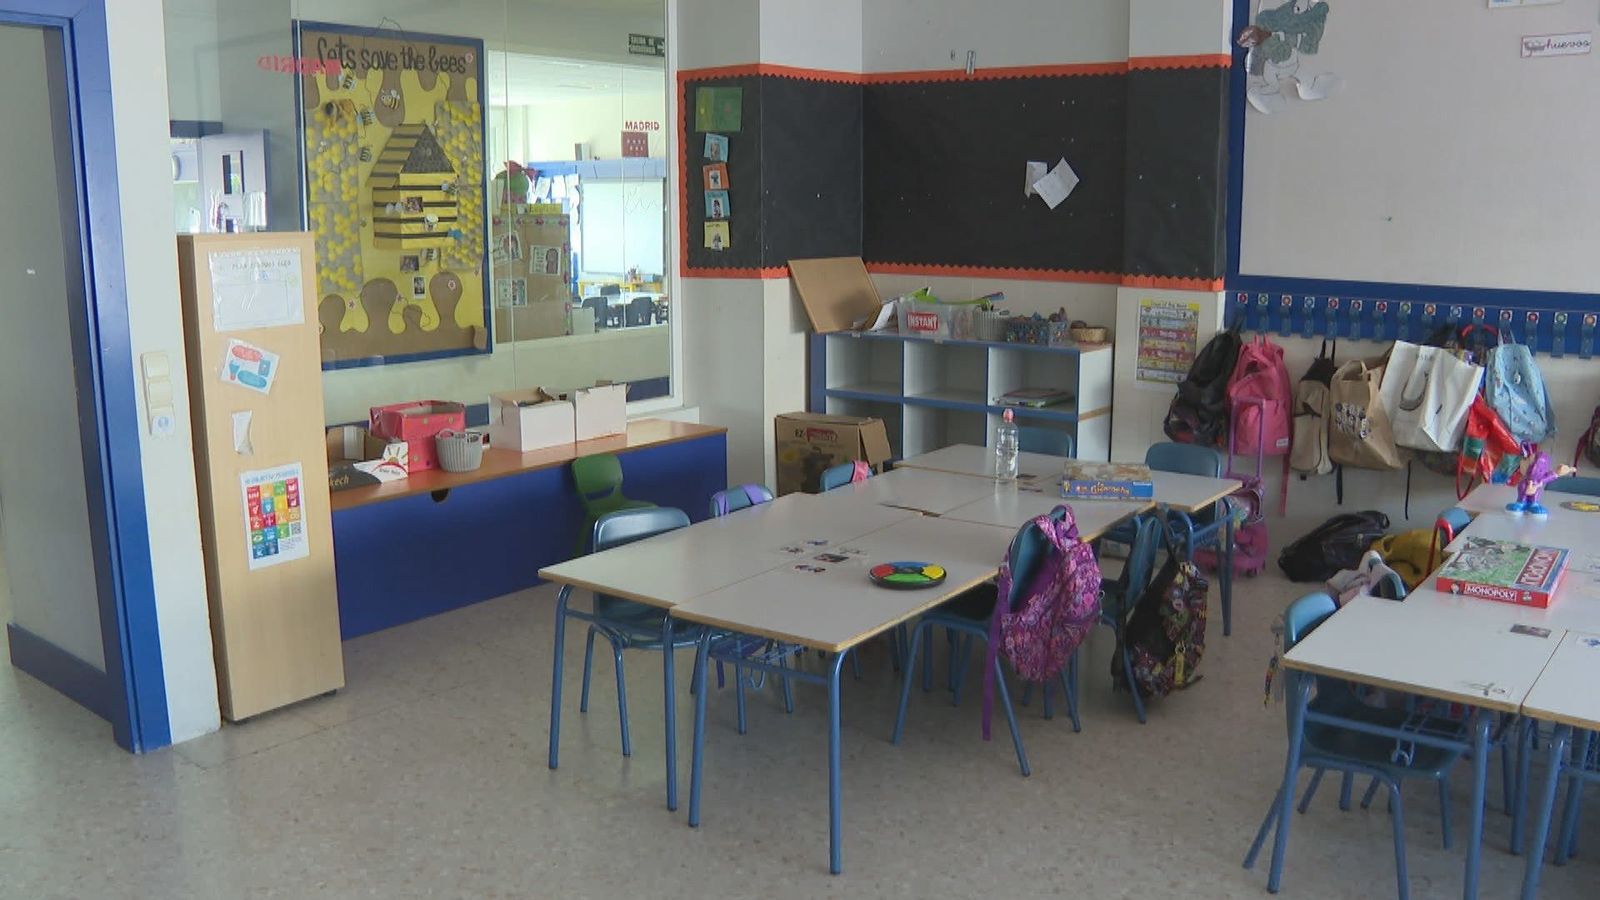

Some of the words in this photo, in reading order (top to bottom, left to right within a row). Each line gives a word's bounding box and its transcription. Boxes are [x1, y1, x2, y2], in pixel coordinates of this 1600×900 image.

[361, 49, 398, 70] save
[403, 46, 424, 70] the
[428, 45, 467, 74] bees
[625, 121, 660, 130] MADRID
[907, 313, 938, 329] INSTANT
[1466, 584, 1516, 601] MONOPOLY
